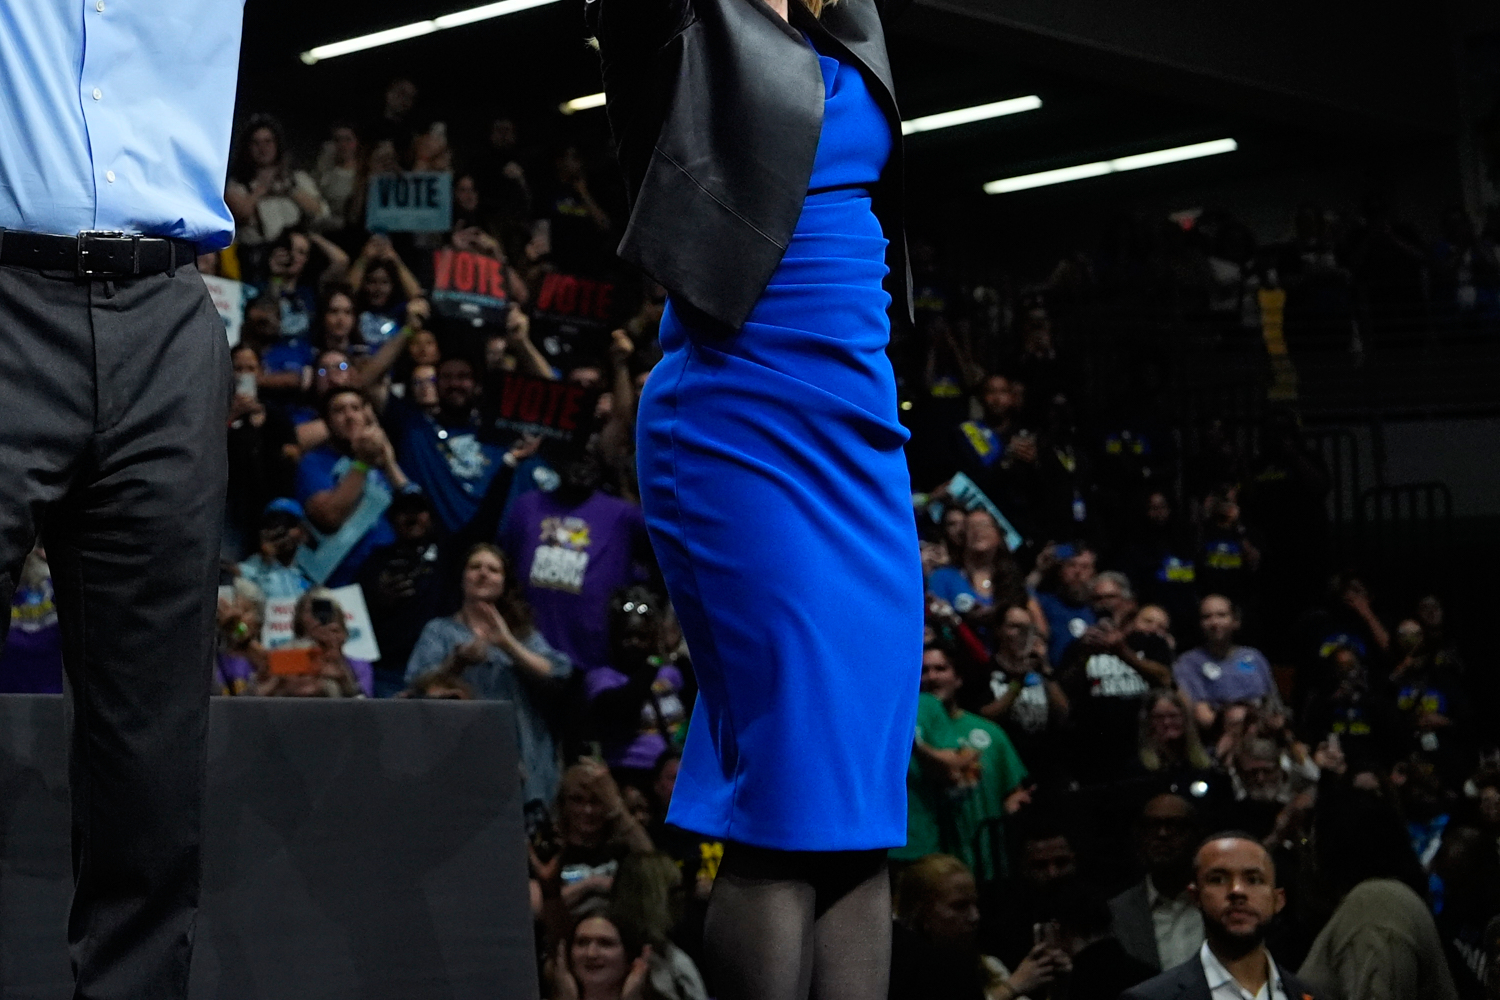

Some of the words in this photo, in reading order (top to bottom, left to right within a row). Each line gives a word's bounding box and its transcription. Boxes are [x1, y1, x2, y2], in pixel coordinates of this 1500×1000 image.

[378, 175, 439, 208] VOTE
[432, 250, 506, 300] VOTE
[536, 272, 615, 320] VOTE
[501, 373, 585, 430] VOTE
